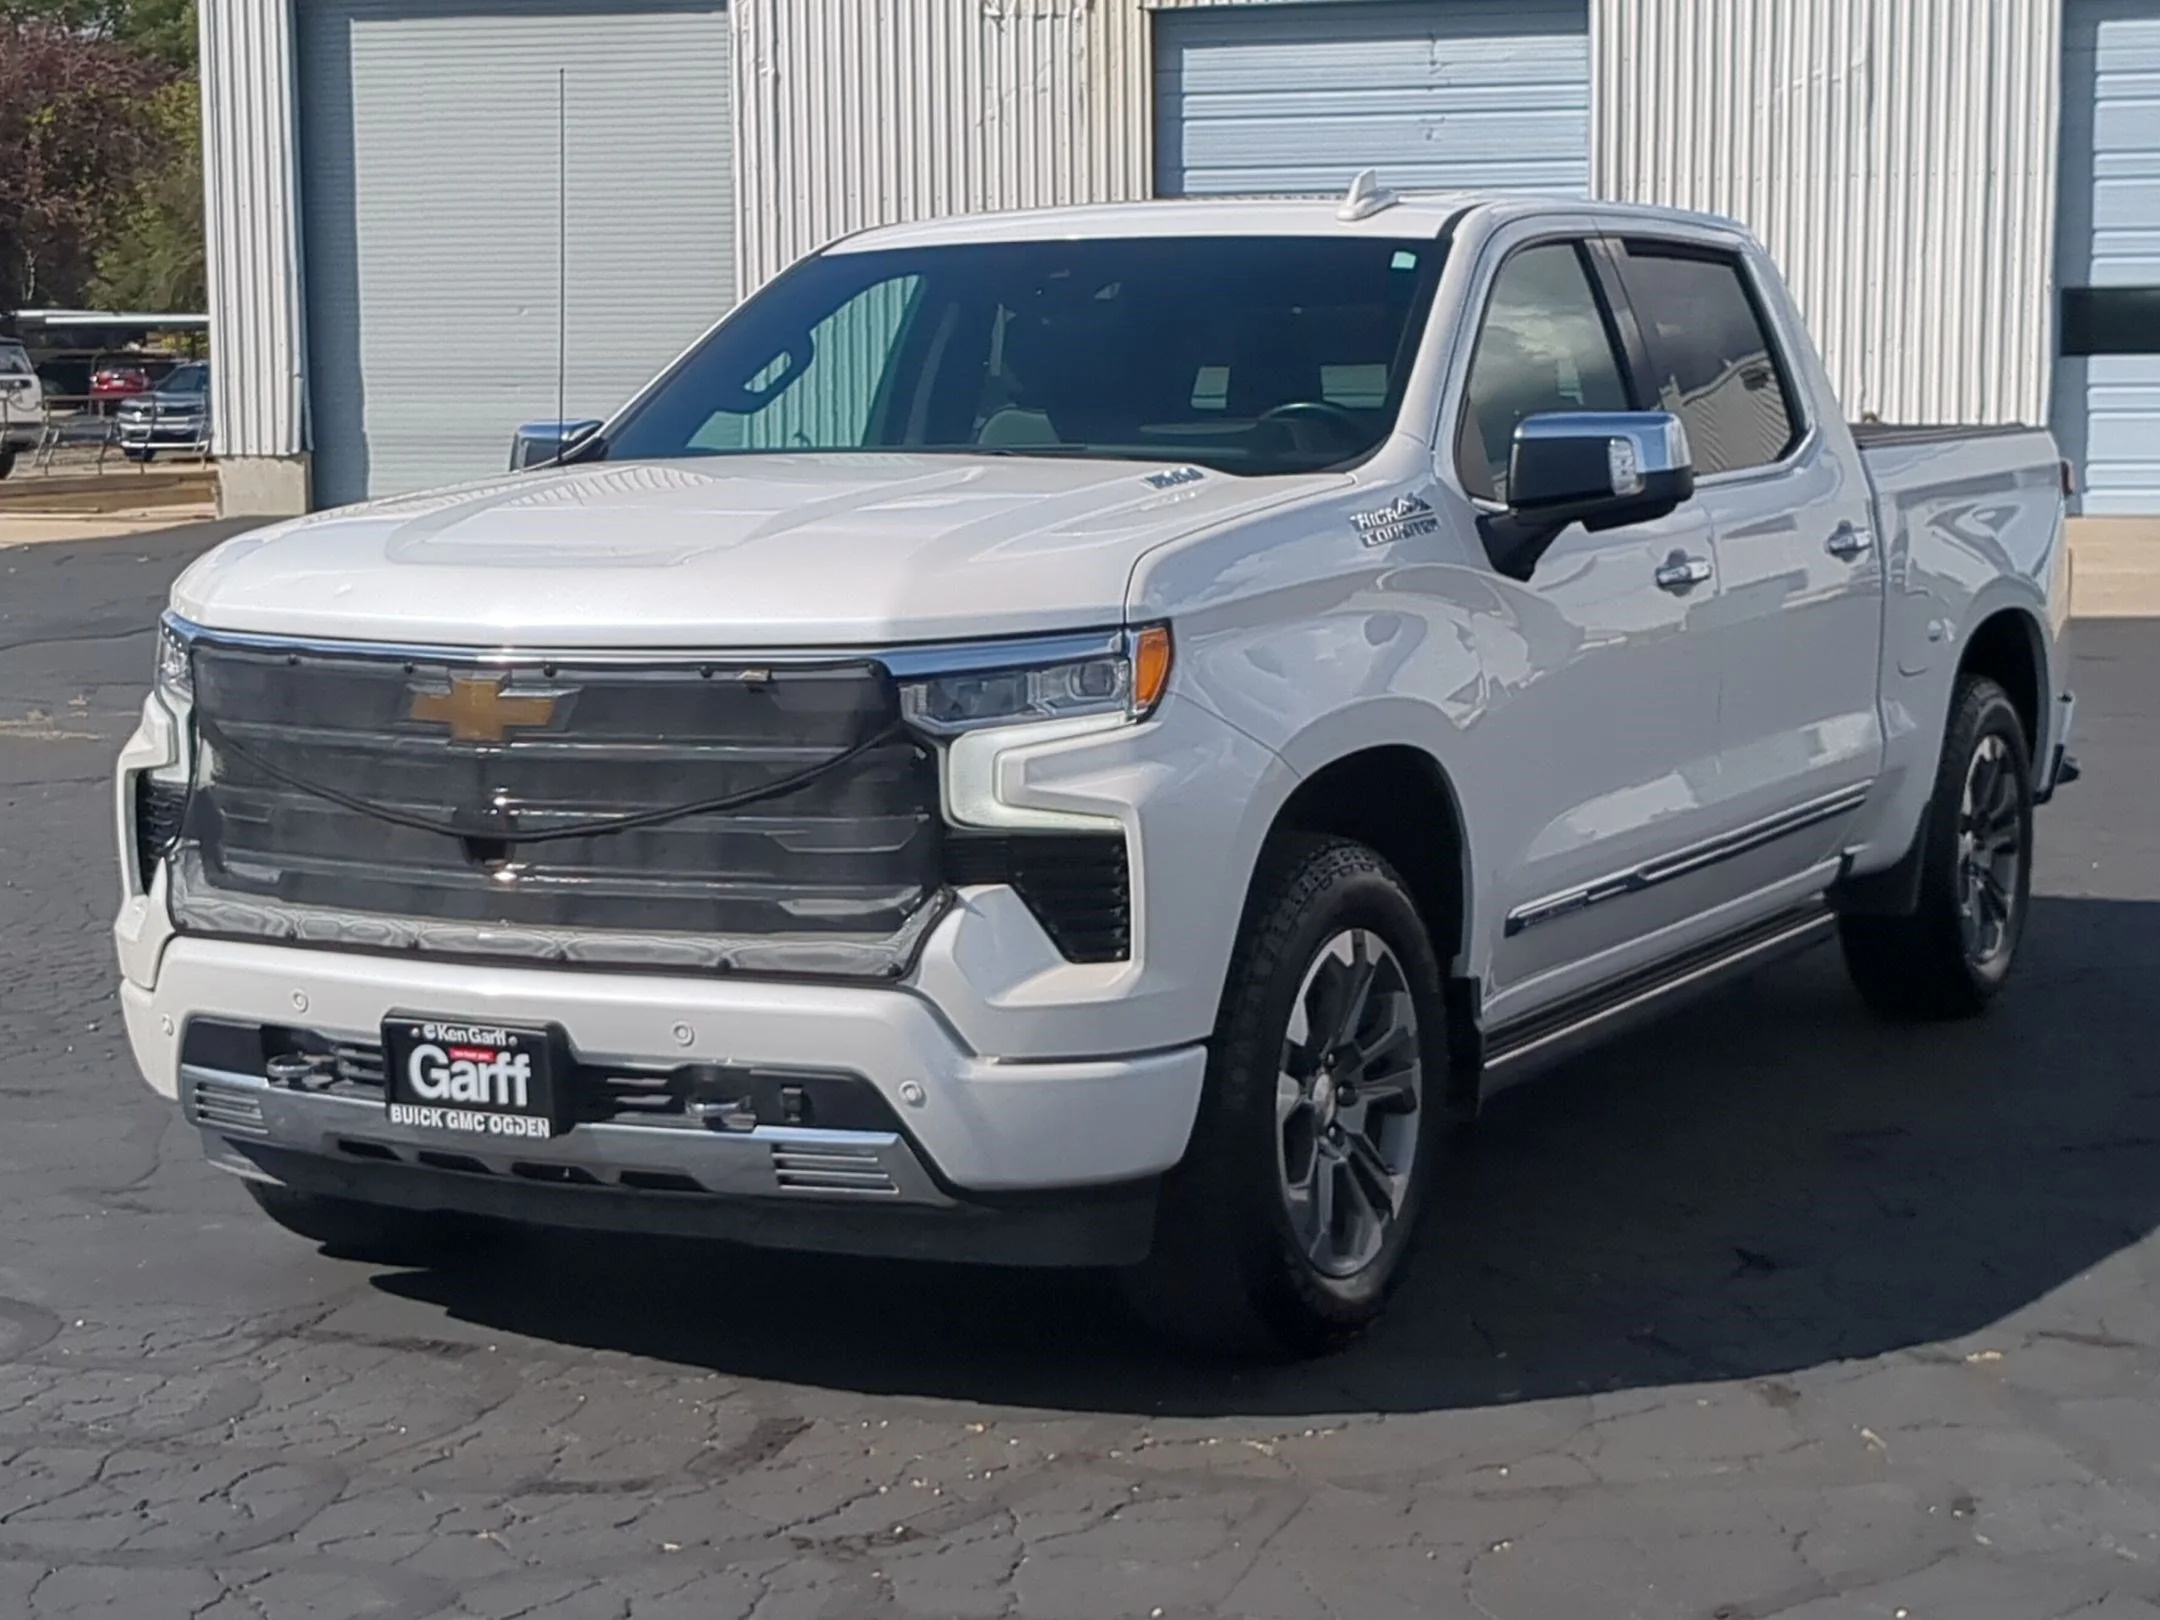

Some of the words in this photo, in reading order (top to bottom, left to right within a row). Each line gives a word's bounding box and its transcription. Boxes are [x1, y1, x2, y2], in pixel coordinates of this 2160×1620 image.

[437, 1024, 468, 1043] Ken
[468, 1027, 507, 1046] Garff
[408, 1044, 531, 1107] Garff
[390, 1104, 443, 1128] BUICK
[446, 1109, 485, 1132] GMC
[489, 1114, 550, 1139] OGDEN
